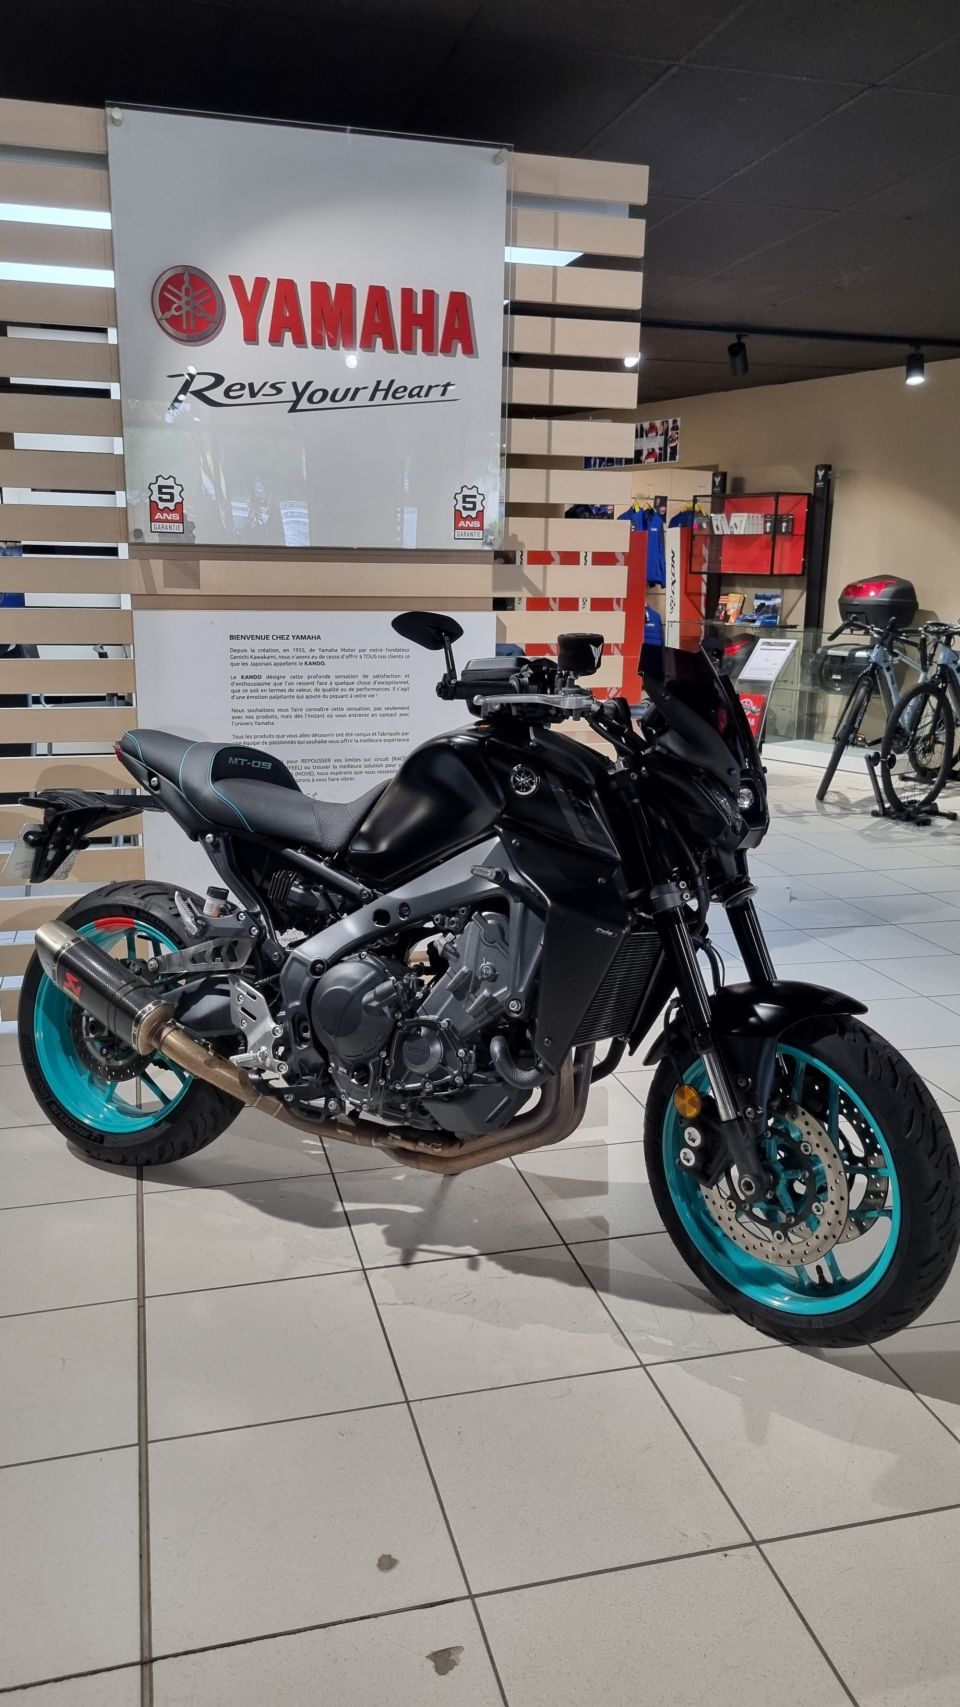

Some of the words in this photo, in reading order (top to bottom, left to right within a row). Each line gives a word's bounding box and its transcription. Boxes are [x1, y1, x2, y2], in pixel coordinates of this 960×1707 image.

[228, 274, 477, 357] YAMAHA
[166, 370, 292, 409] Revs
[288, 380, 370, 413] Your
[369, 379, 457, 401] Heart
[157, 484, 175, 503] 5
[462, 494, 477, 511] 5
[154, 512, 180, 520] ANS
[153, 523, 182, 532] GARANTIE
[458, 520, 481, 528] ANS
[228, 756, 273, 770] MT-09
